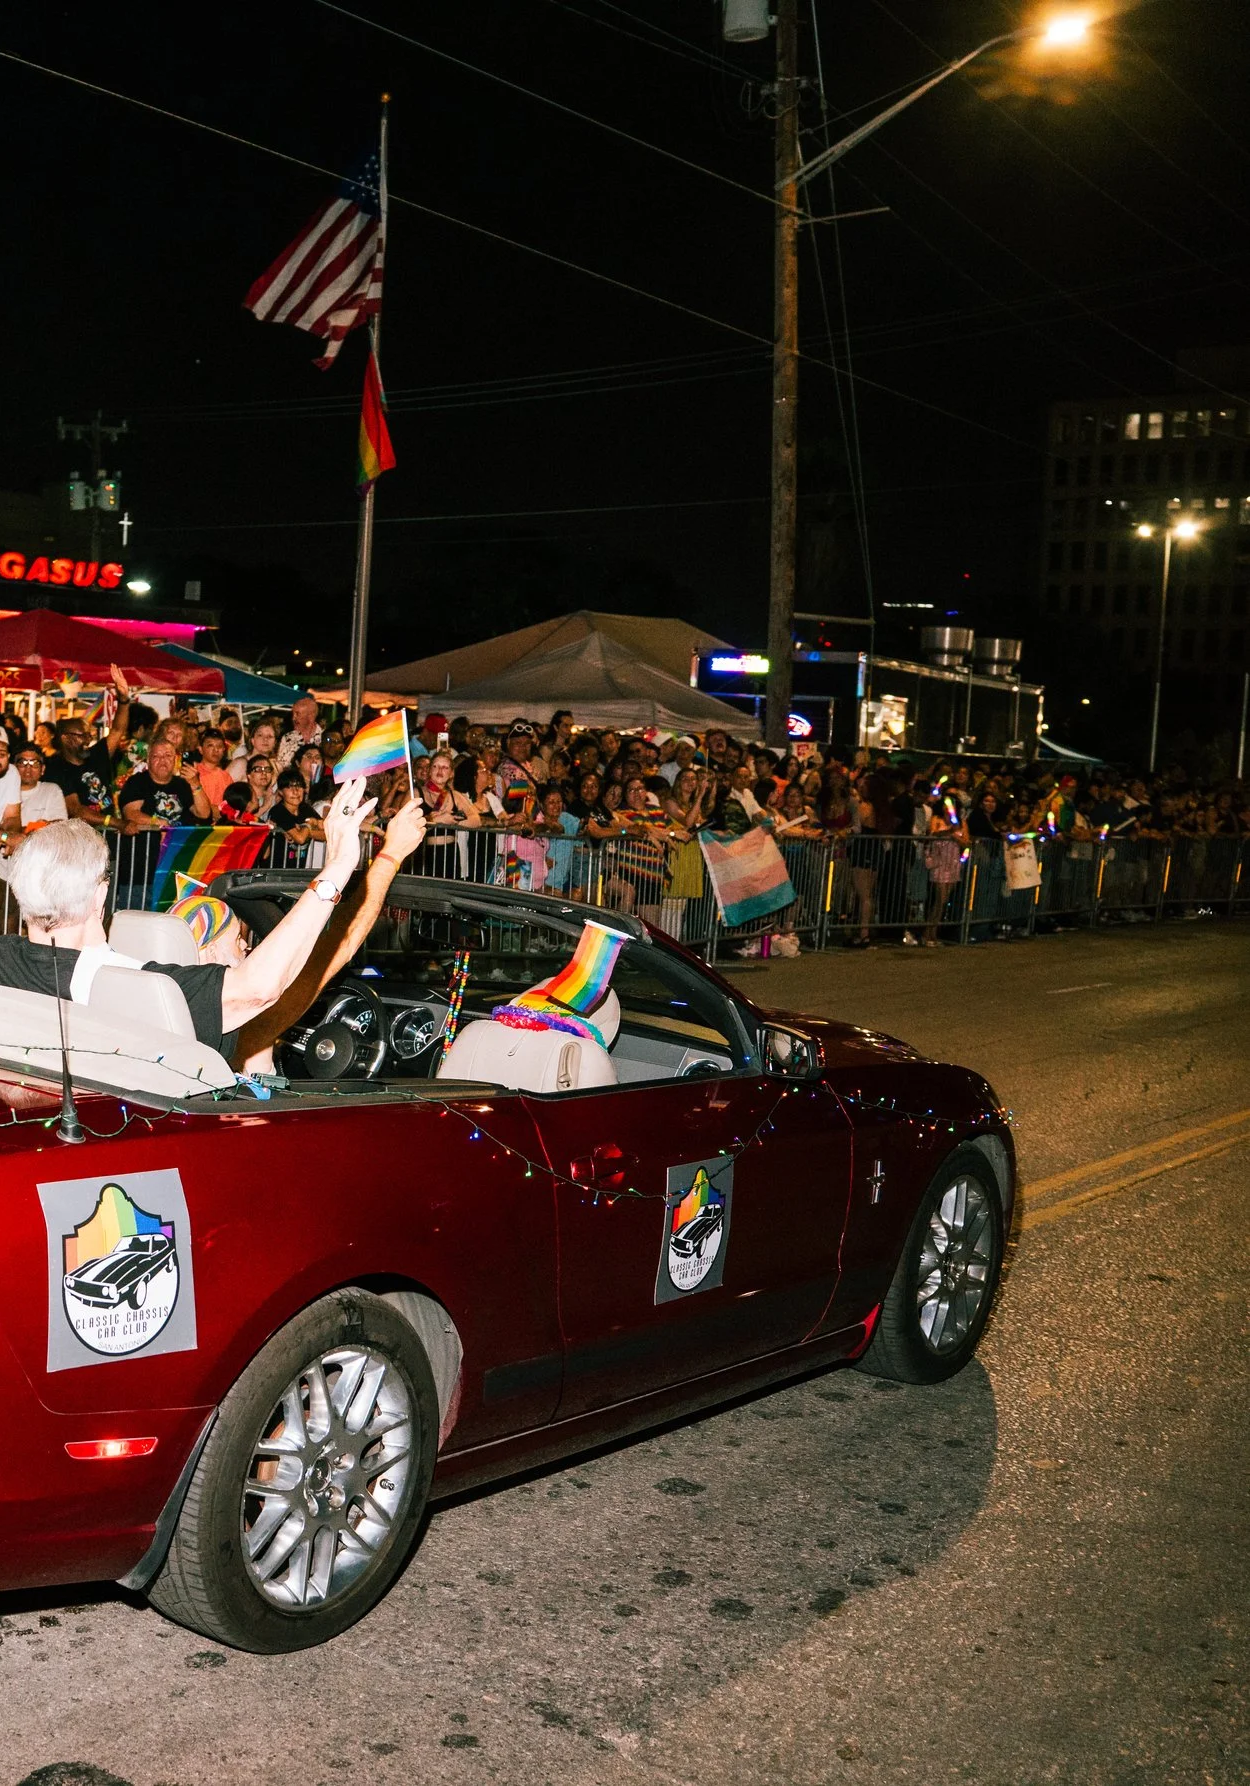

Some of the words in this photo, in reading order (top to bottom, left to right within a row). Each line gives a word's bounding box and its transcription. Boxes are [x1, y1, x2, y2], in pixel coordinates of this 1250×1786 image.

[670, 1261, 691, 1273] CLASSIC
[693, 1255, 714, 1268] CHASSIS
[679, 1271, 689, 1280] CAR
[690, 1266, 703, 1277] CLUB
[75, 1313, 120, 1330] CLASSIC
[126, 1306, 169, 1323] CHASSIS
[97, 1328, 116, 1339] CAR
[123, 1322, 148, 1336] CLUB
[98, 1341, 114, 1352] SAN
[114, 1335, 147, 1351] ANTONIO
